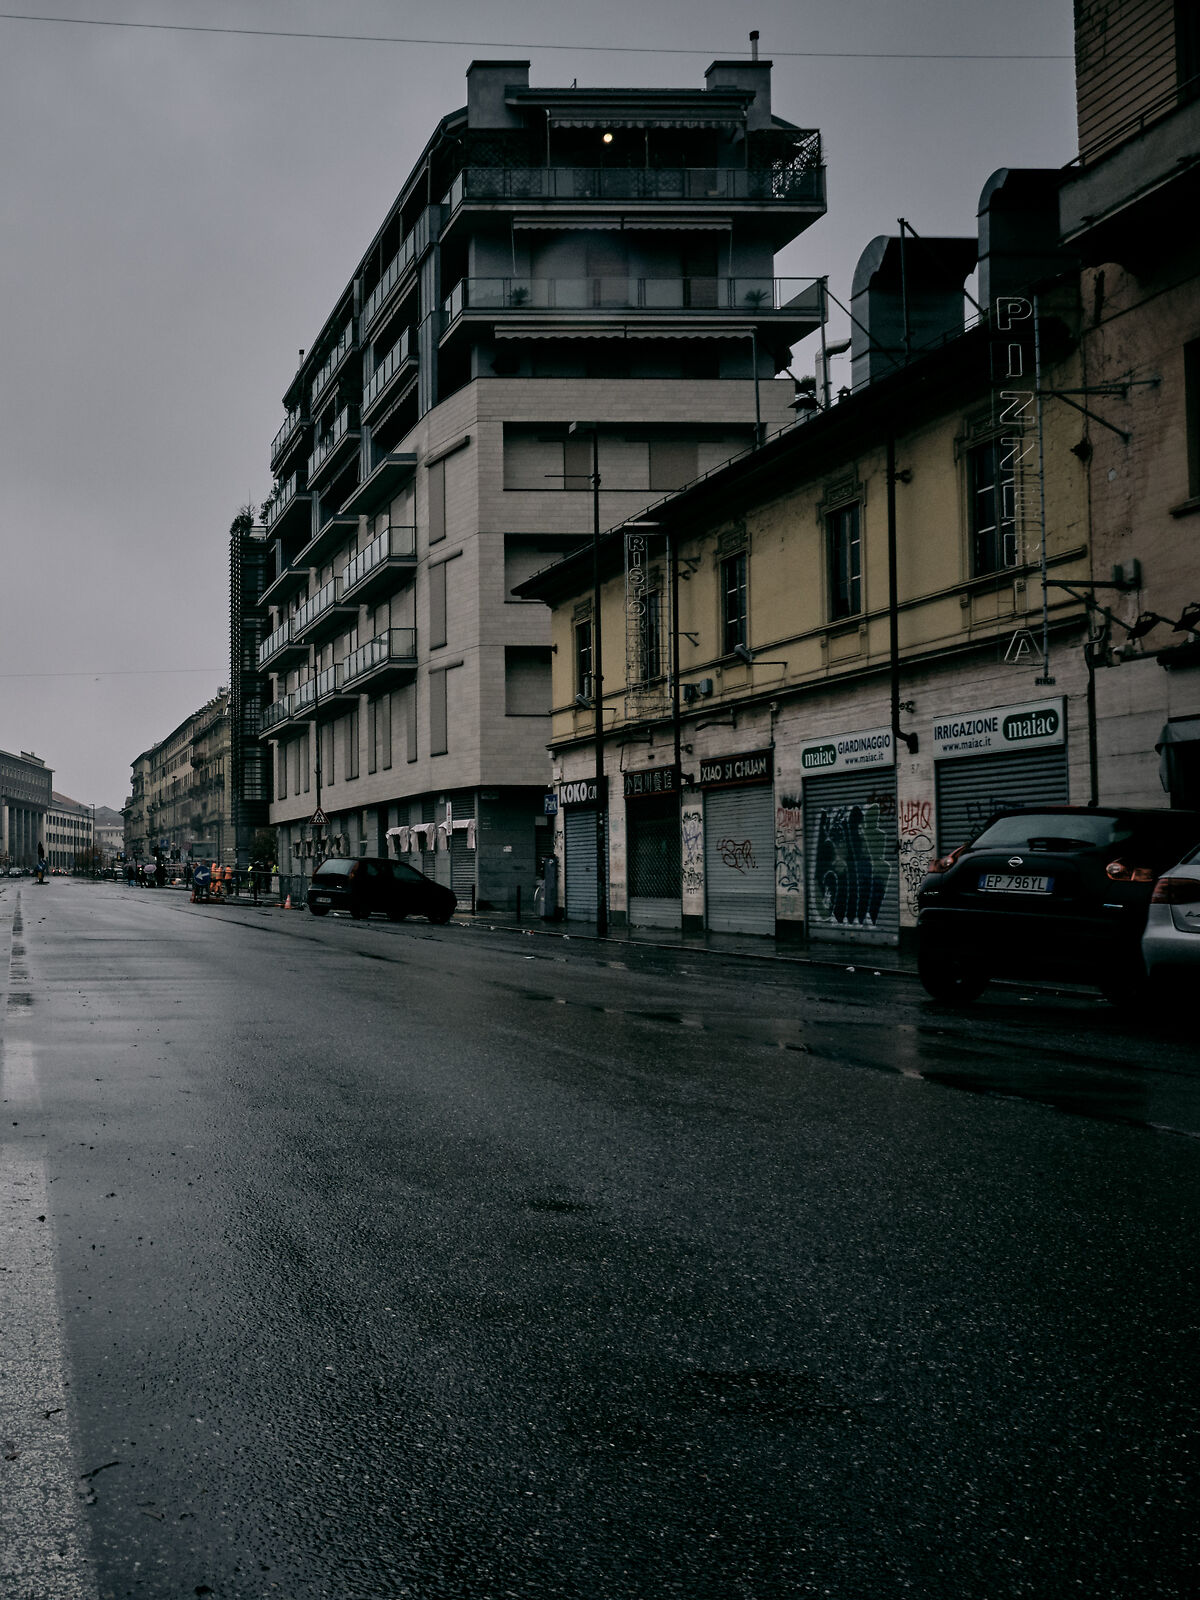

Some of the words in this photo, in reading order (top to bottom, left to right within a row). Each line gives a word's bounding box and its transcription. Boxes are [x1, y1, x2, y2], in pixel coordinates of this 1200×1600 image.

[934, 717, 998, 740] IRRIGAZIONE
[1008, 713, 1055, 738] maiac
[805, 747, 834, 767] maiac
[838, 734, 891, 754] GIARDINAGGIO
[942, 737, 991, 751] www.maiac.it
[701, 764, 722, 781] XIAO
[725, 763, 733, 779] SI
[734, 757, 767, 777] CHUAN
[845, 752, 884, 764] www.maiac.it
[560, 782, 587, 804] KOKO
[986, 876, 1002, 888] EP
[1006, 876, 1045, 890] 796YL
